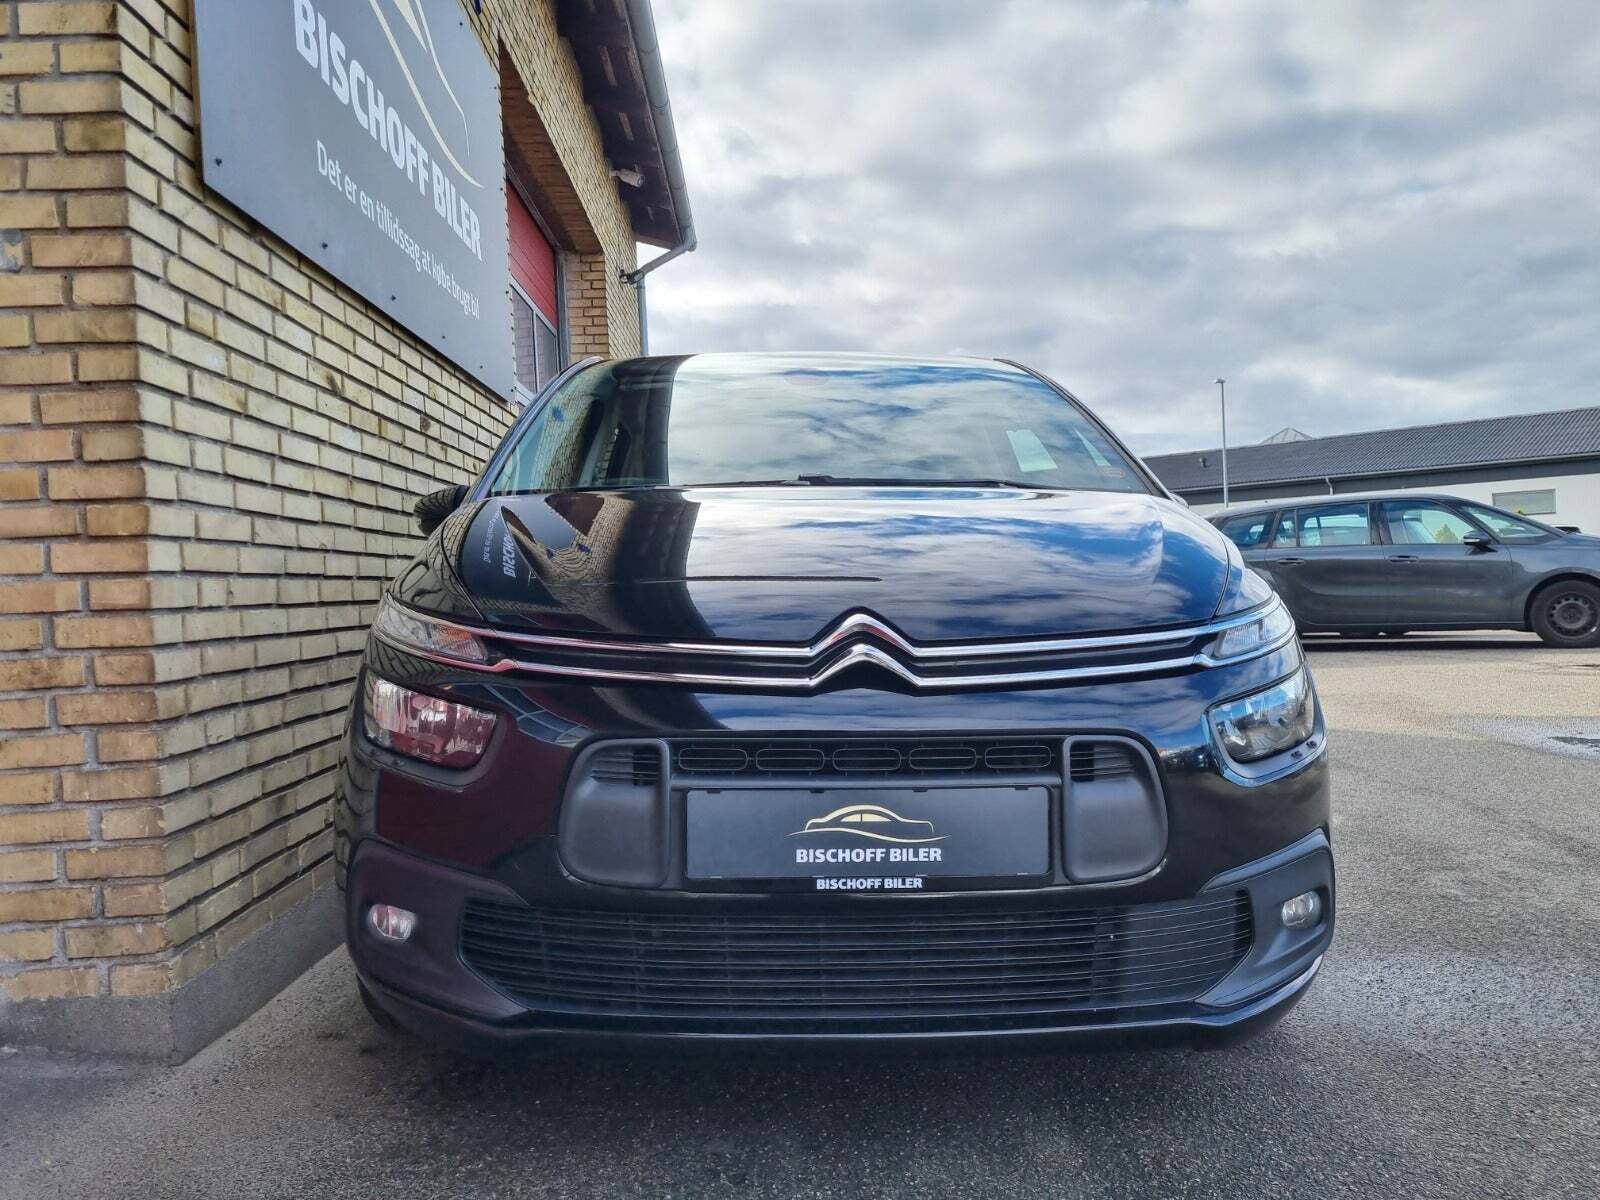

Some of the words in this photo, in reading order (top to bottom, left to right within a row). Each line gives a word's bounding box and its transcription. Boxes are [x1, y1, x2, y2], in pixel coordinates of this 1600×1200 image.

[294, 0, 428, 197] BISCHOFF
[432, 160, 482, 262] BILER
[317, 140, 342, 192] Det
[344, 175, 358, 205] er
[360, 190, 375, 222] en
[376, 200, 421, 272] tillidssag
[421, 250, 432, 275] at
[452, 273, 472, 316] brugt
[795, 848, 886, 863] BISCHOFF
[889, 847, 942, 862] BILER
[816, 878, 882, 890] BISCHOFF
[884, 877, 923, 889] BILER
